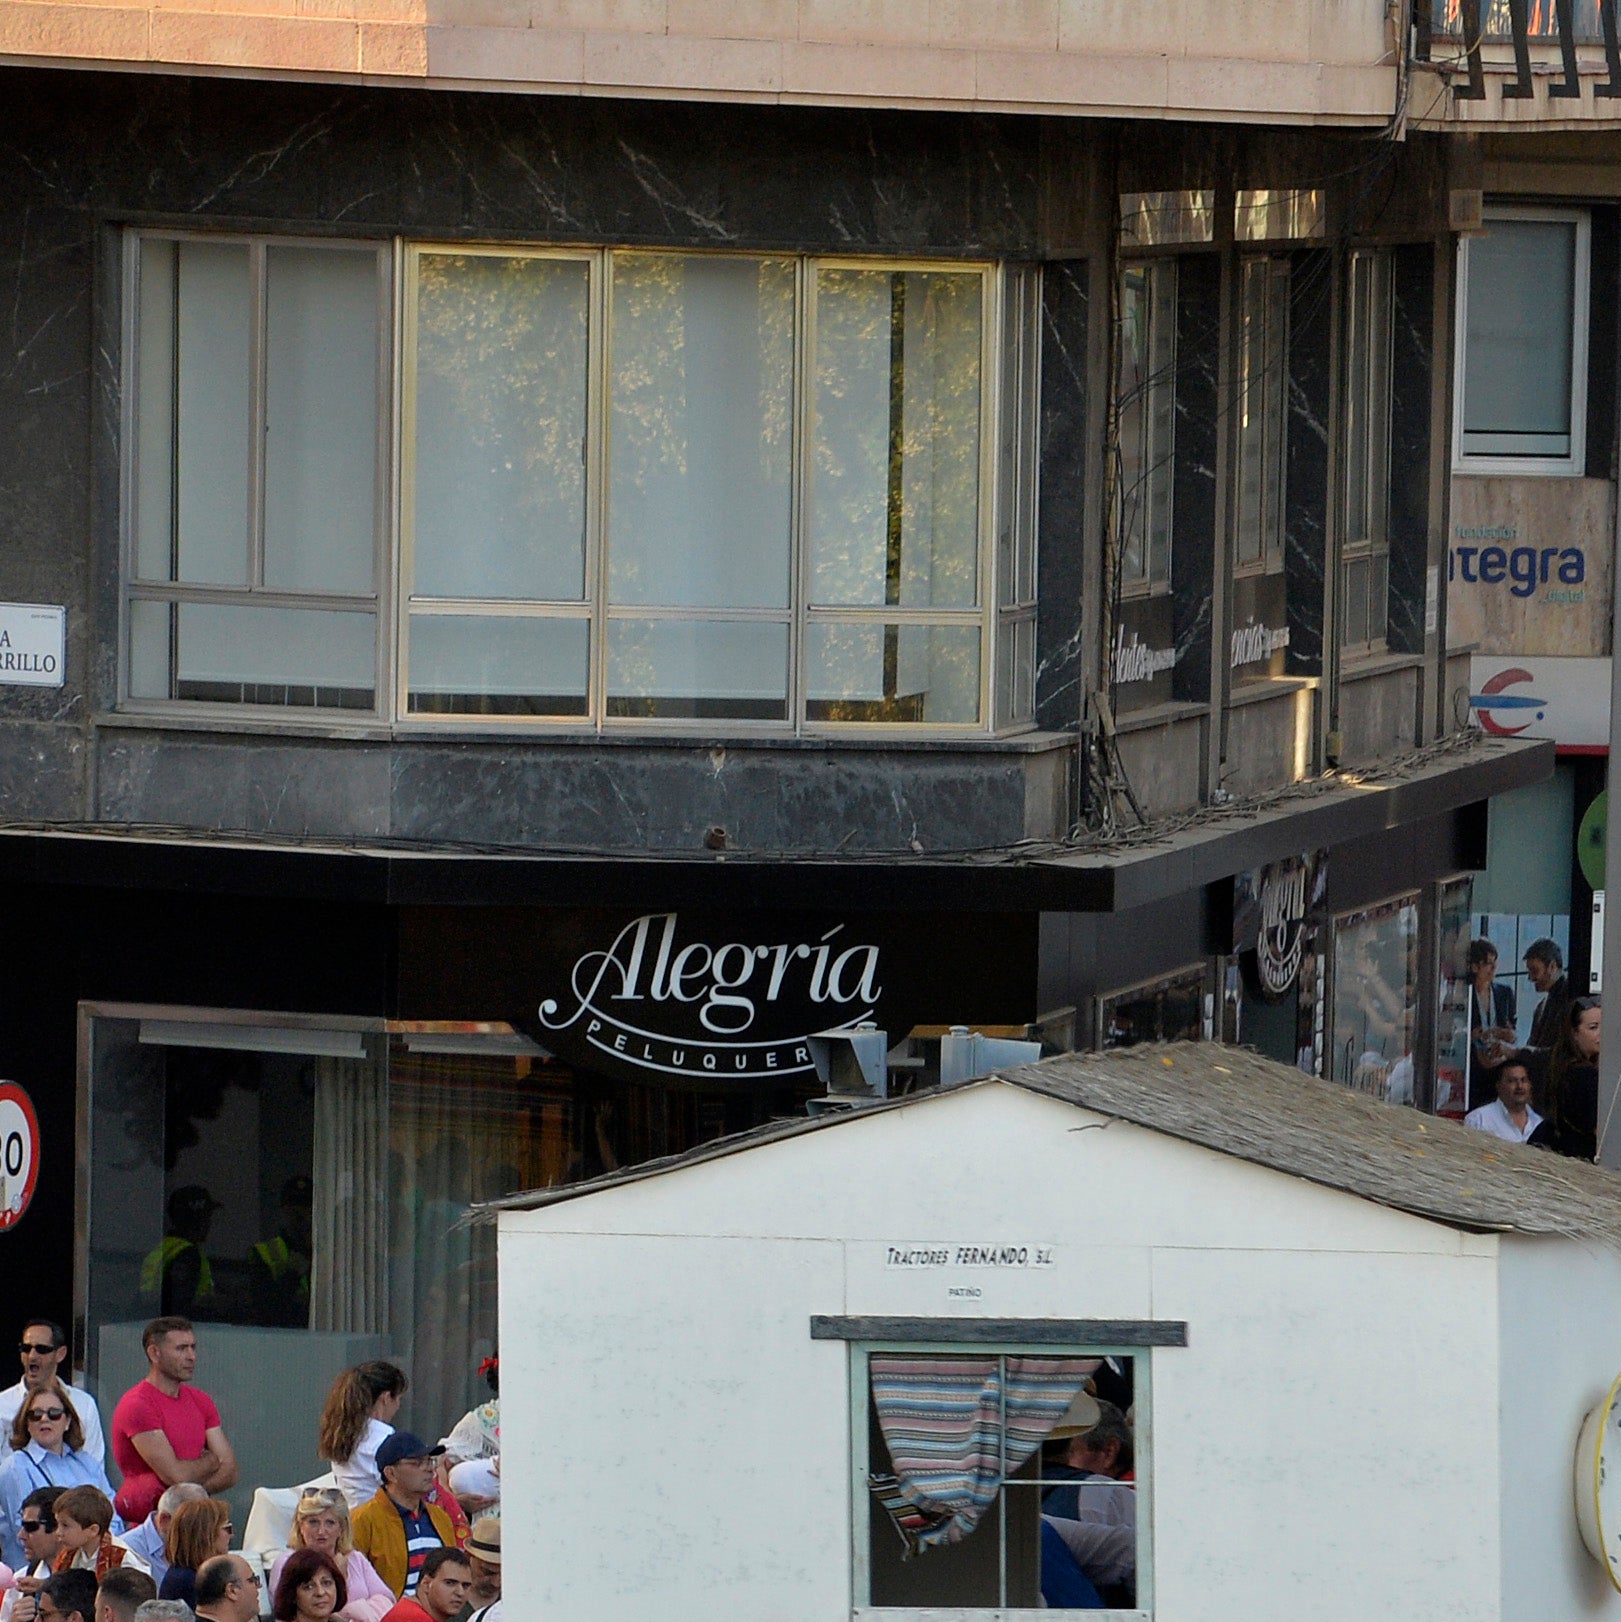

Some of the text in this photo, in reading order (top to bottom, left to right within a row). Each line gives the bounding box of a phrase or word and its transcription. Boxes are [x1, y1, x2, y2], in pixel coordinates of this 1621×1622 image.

[1449, 546, 1585, 598] tegra
[539, 912, 883, 1034] Alegría
[585, 1018, 811, 1071] PELUQUER
[0, 1131, 23, 1177] 0
